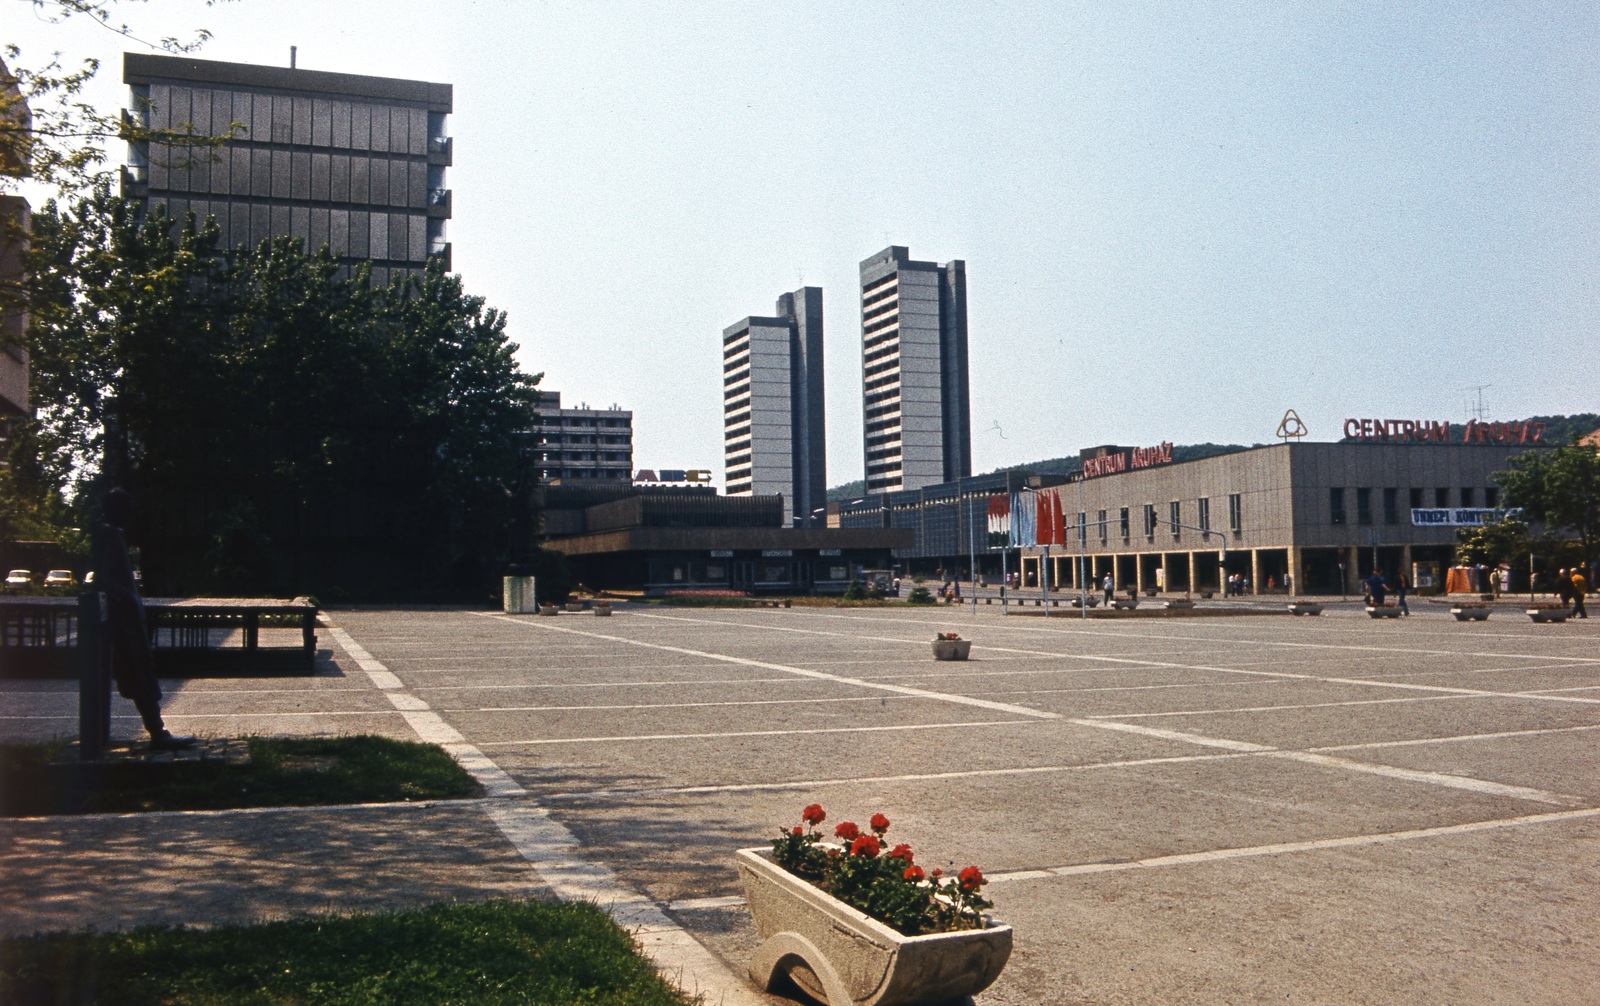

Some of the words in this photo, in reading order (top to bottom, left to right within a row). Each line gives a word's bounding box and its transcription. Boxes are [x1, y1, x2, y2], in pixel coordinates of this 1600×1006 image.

[1344, 418, 1450, 442] CENTRUM
[1464, 418, 1546, 444] ÁRUHÁZ
[1083, 452, 1126, 478] CENTRUM
[1131, 440, 1174, 469] ÁRUHÁZ
